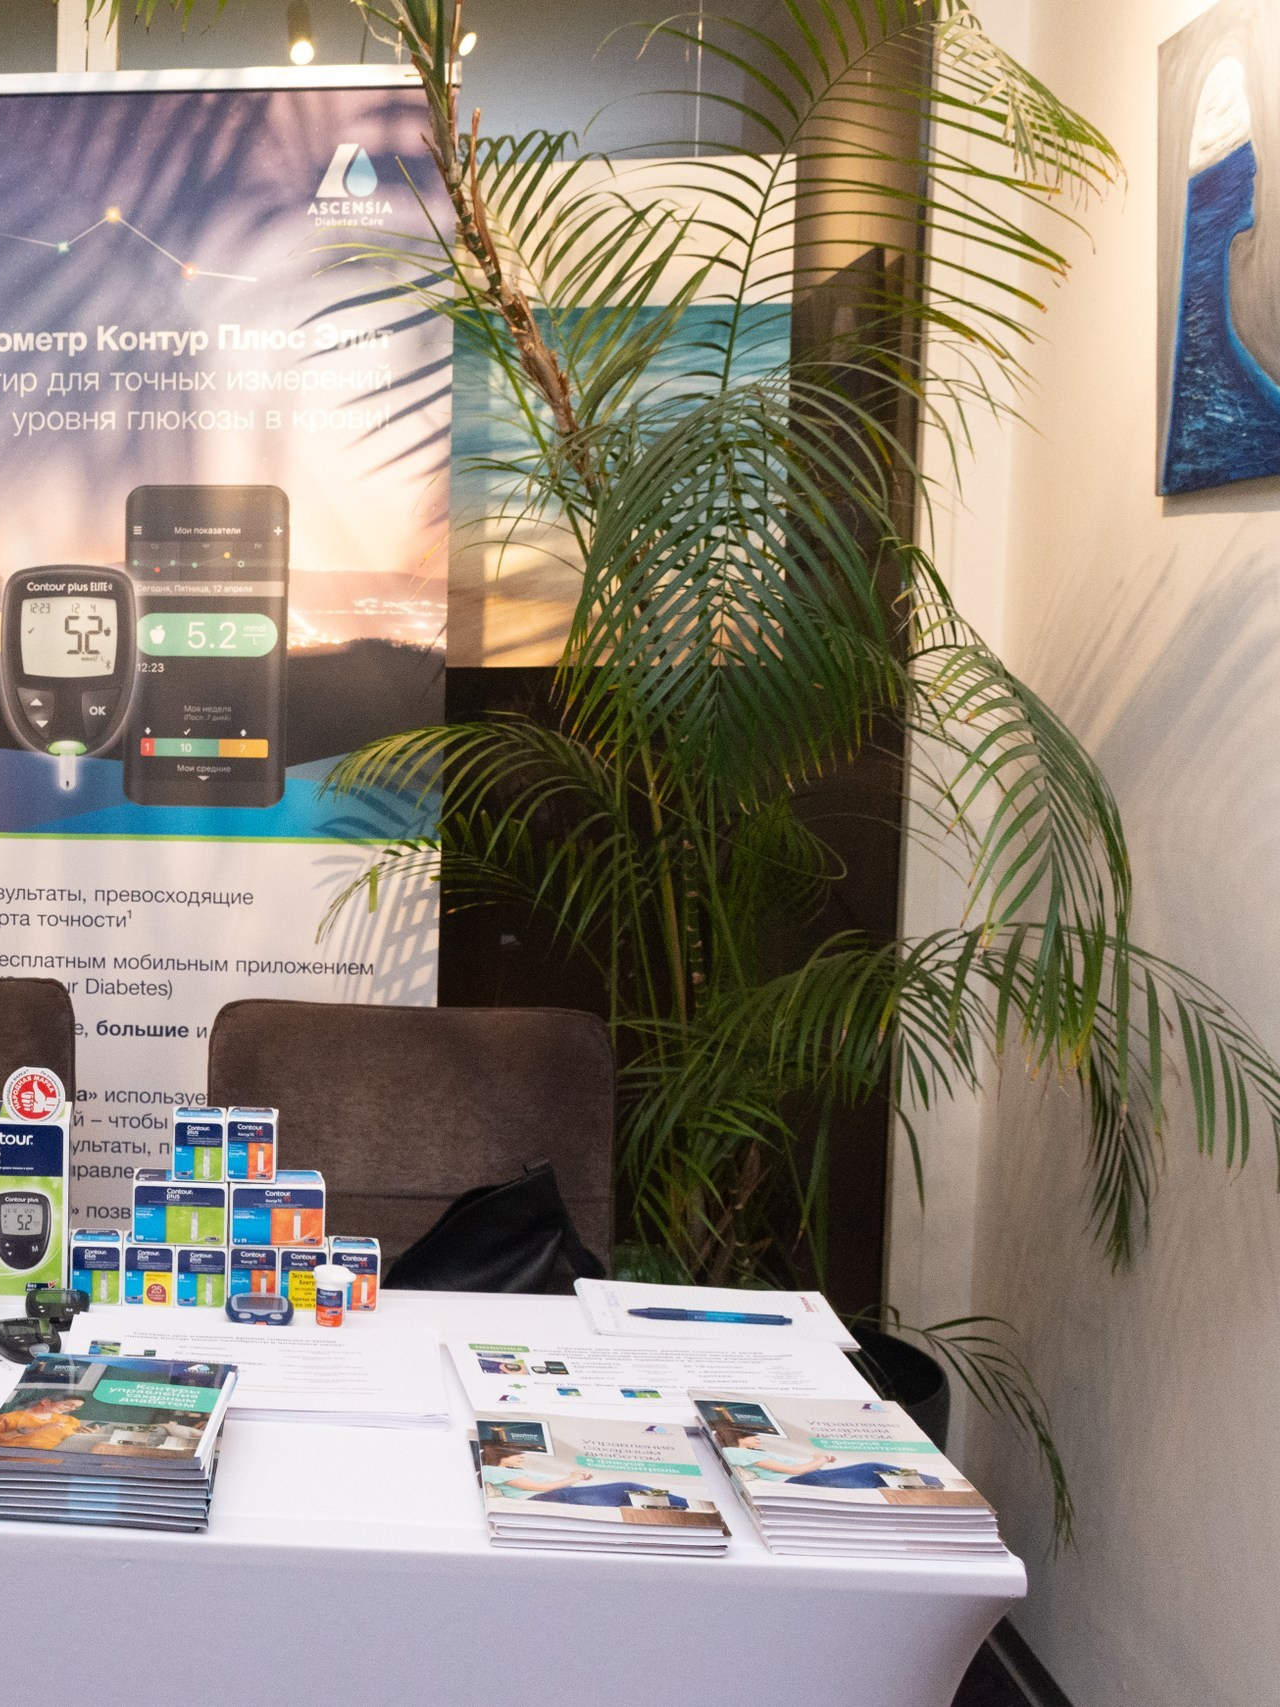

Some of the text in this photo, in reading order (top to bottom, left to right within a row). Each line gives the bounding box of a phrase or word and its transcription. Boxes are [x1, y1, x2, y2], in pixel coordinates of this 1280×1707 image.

[307, 200, 393, 216] ASCENSIA
[314, 216, 385, 228] Diabetes Care
[96, 325, 209, 357] Контур
[218, 323, 307, 352] Плюс
[314, 322, 394, 351] Элит
[46, 371, 100, 397] для
[110, 371, 217, 392] точных
[226, 364, 393, 396] измерений
[12, 404, 391, 437] уровня глюкозы в крови!
[174, 526, 242, 536] Мои показатели
[26, 582, 108, 594] Contour plus ELITE
[174, 584, 211, 594] Пятница,
[213, 585, 222, 593] 12
[223, 585, 253, 595] апреля
[187, 621, 238, 649] 5.2
[136, 662, 165, 673] 12:23
[89, 705, 107, 716] OK
[183, 704, 232, 714] Моя неделя
[180, 743, 193, 753] 10
[176, 764, 232, 774] Мои средние
[94, 889, 254, 907] превосходящие
[113, 954, 228, 972] мобильным
[235, 959, 374, 977] приложением
[85, 978, 173, 1000] Diabetes)
[96, 1020, 189, 1038] большие
[196, 1025, 207, 1039] и
[12, 1075, 32, 1110] НАРОДНАЯ
[33, 1075, 55, 1093] МАРКА
[108, 1112, 168, 1130] чтобы
[150, 1284, 162, 1294] 25
[108, 1387, 199, 1399] управления
[135, 1384, 201, 1395] Контуры
[125, 1393, 197, 1404] сахарным
[805, 1420, 900, 1429] Управление
[810, 1426, 890, 1435] сахарным
[581, 1438, 675, 1451] Управление
[583, 1445, 662, 1456] сахарным
[823, 1444, 919, 1452] самоконтроль
[587, 1462, 681, 1474] самоконтроль
[597, 1458, 646, 1468] фокусе
